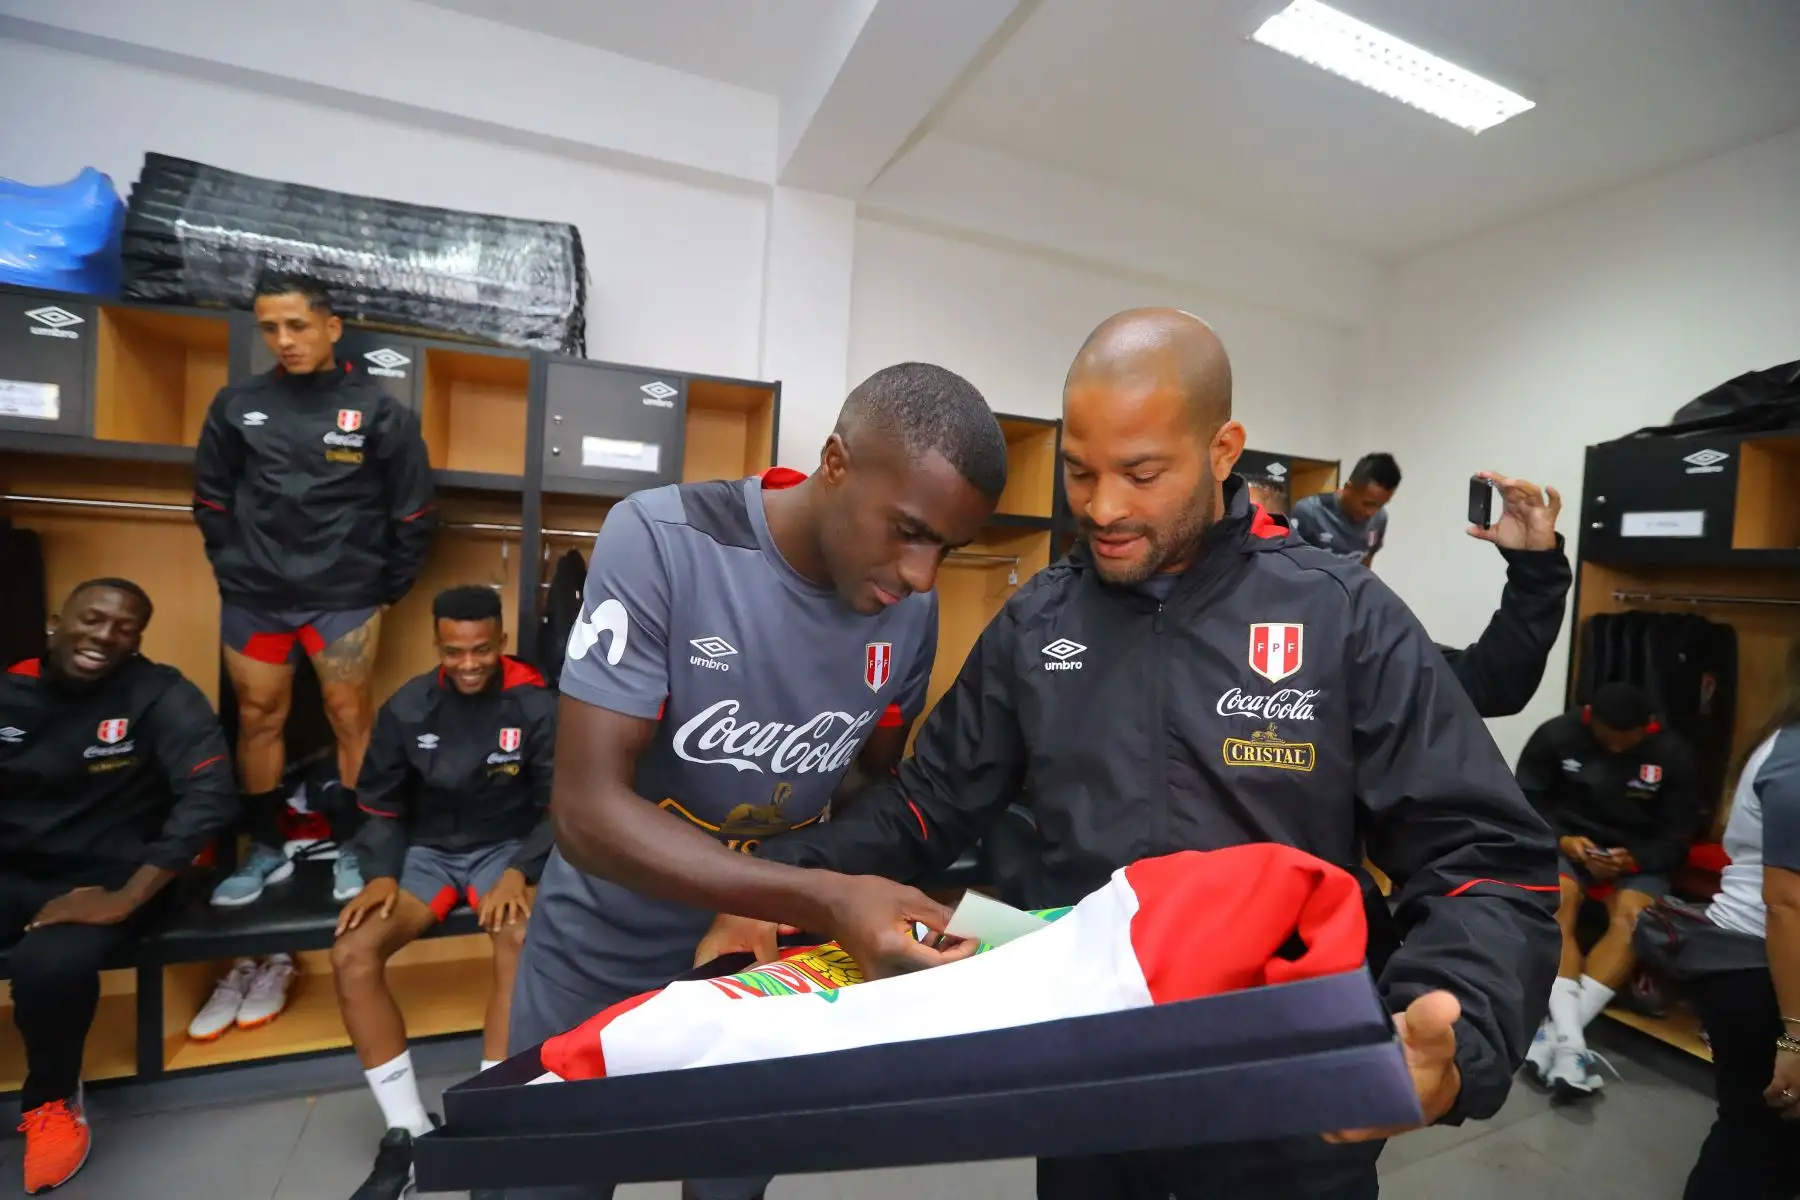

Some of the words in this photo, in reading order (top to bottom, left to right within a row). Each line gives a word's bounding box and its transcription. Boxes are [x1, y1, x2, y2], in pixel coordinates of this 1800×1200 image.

[689, 655, 729, 672] umbro
[1044, 660, 1083, 671] umbro
[1216, 687, 1321, 721] Coca-Cola
[672, 699, 878, 774] Coca-Cola
[1231, 742, 1306, 766] CRISTAL
